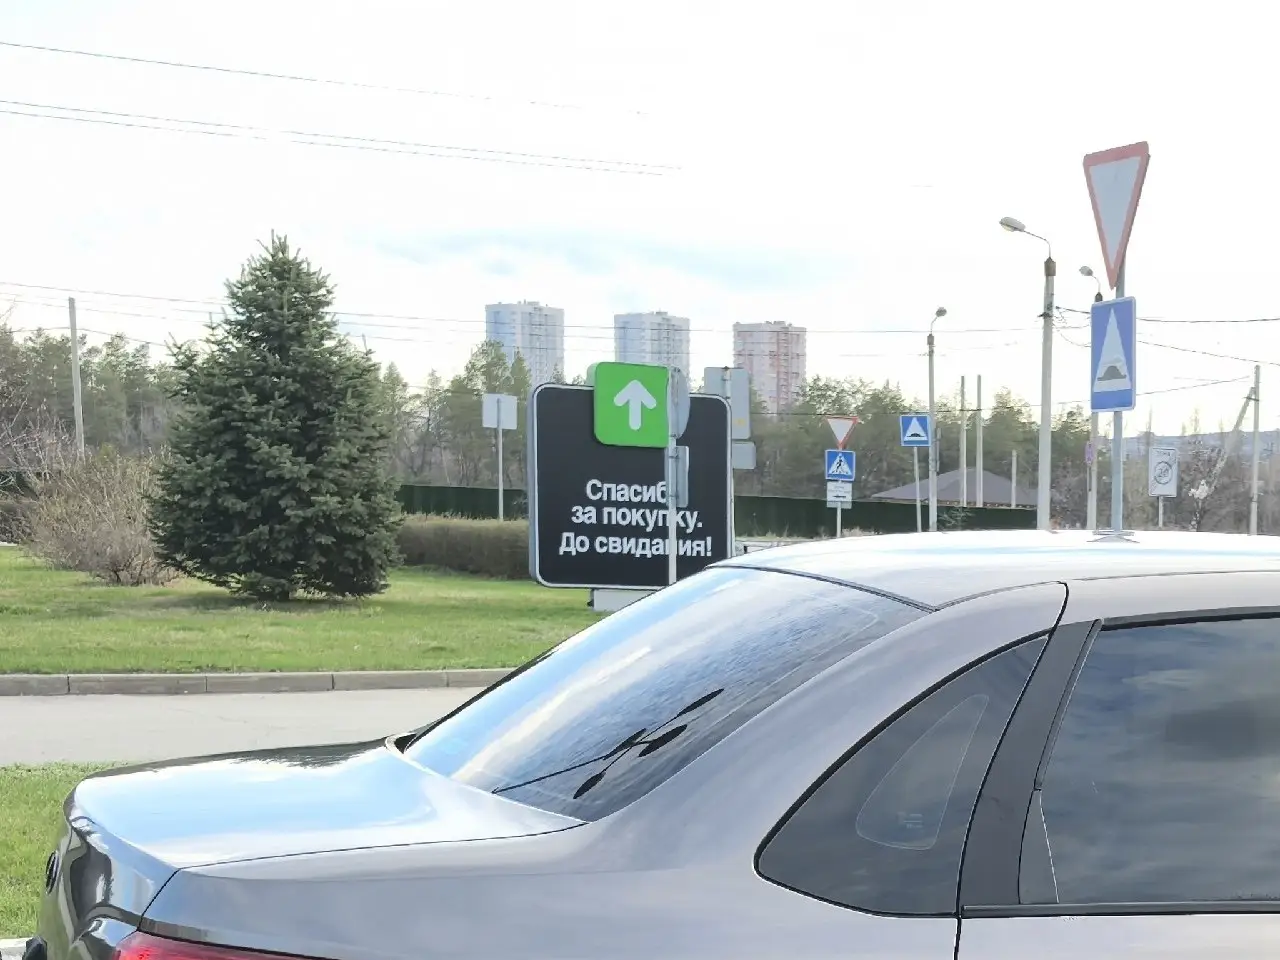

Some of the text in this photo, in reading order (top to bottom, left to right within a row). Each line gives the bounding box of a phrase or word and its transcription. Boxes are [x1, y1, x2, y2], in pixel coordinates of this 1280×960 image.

[586, 478, 668, 503] Спасиб
[571, 505, 703, 533] за покупку.
[558, 531, 590, 556] До
